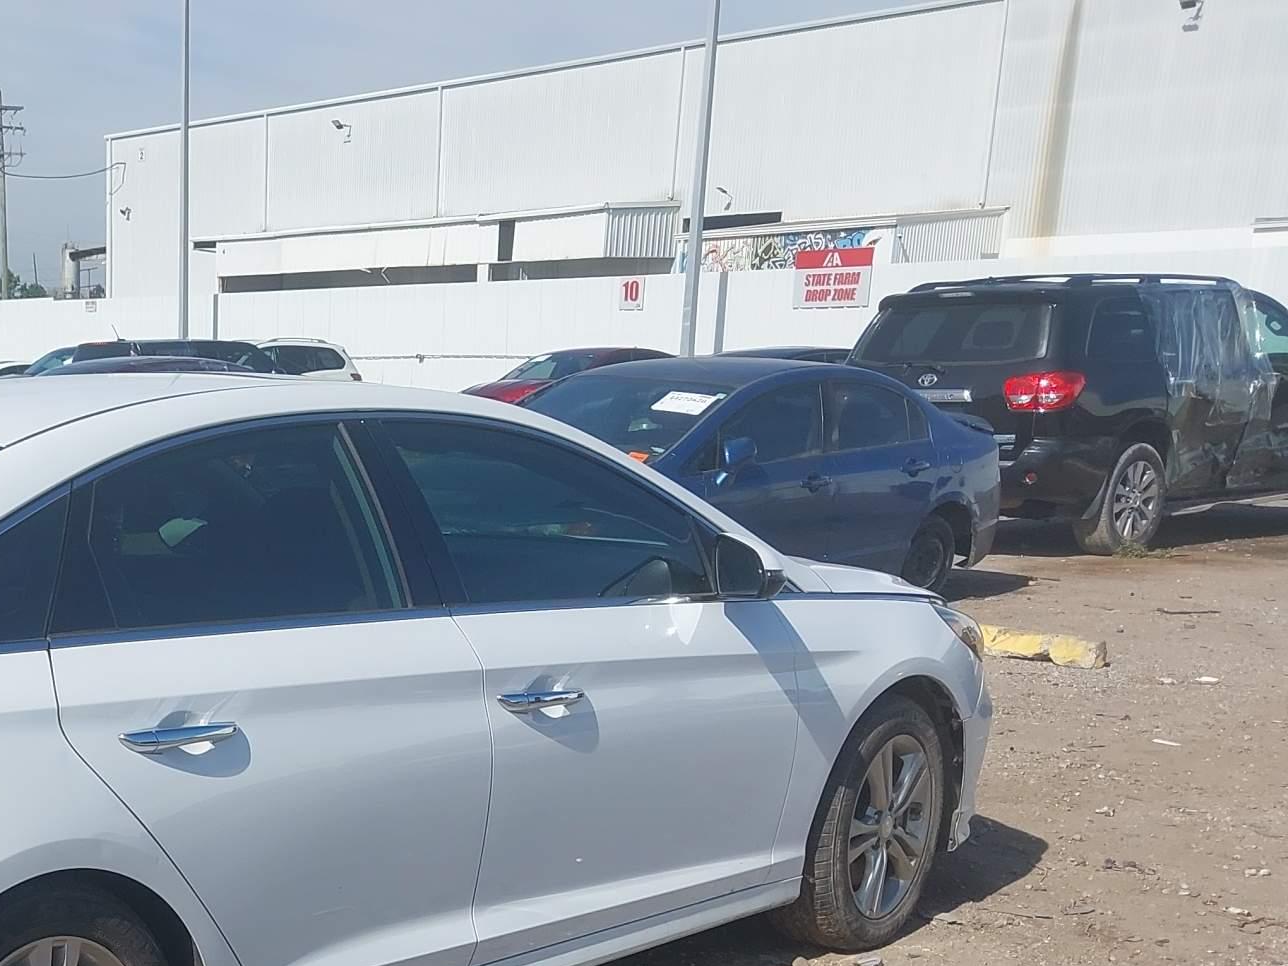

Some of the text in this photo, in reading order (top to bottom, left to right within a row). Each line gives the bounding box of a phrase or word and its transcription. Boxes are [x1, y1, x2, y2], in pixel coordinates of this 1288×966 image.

[804, 271, 861, 287] STATE FARM
[622, 280, 640, 302] 10
[805, 288, 857, 303] DROP ZONE
